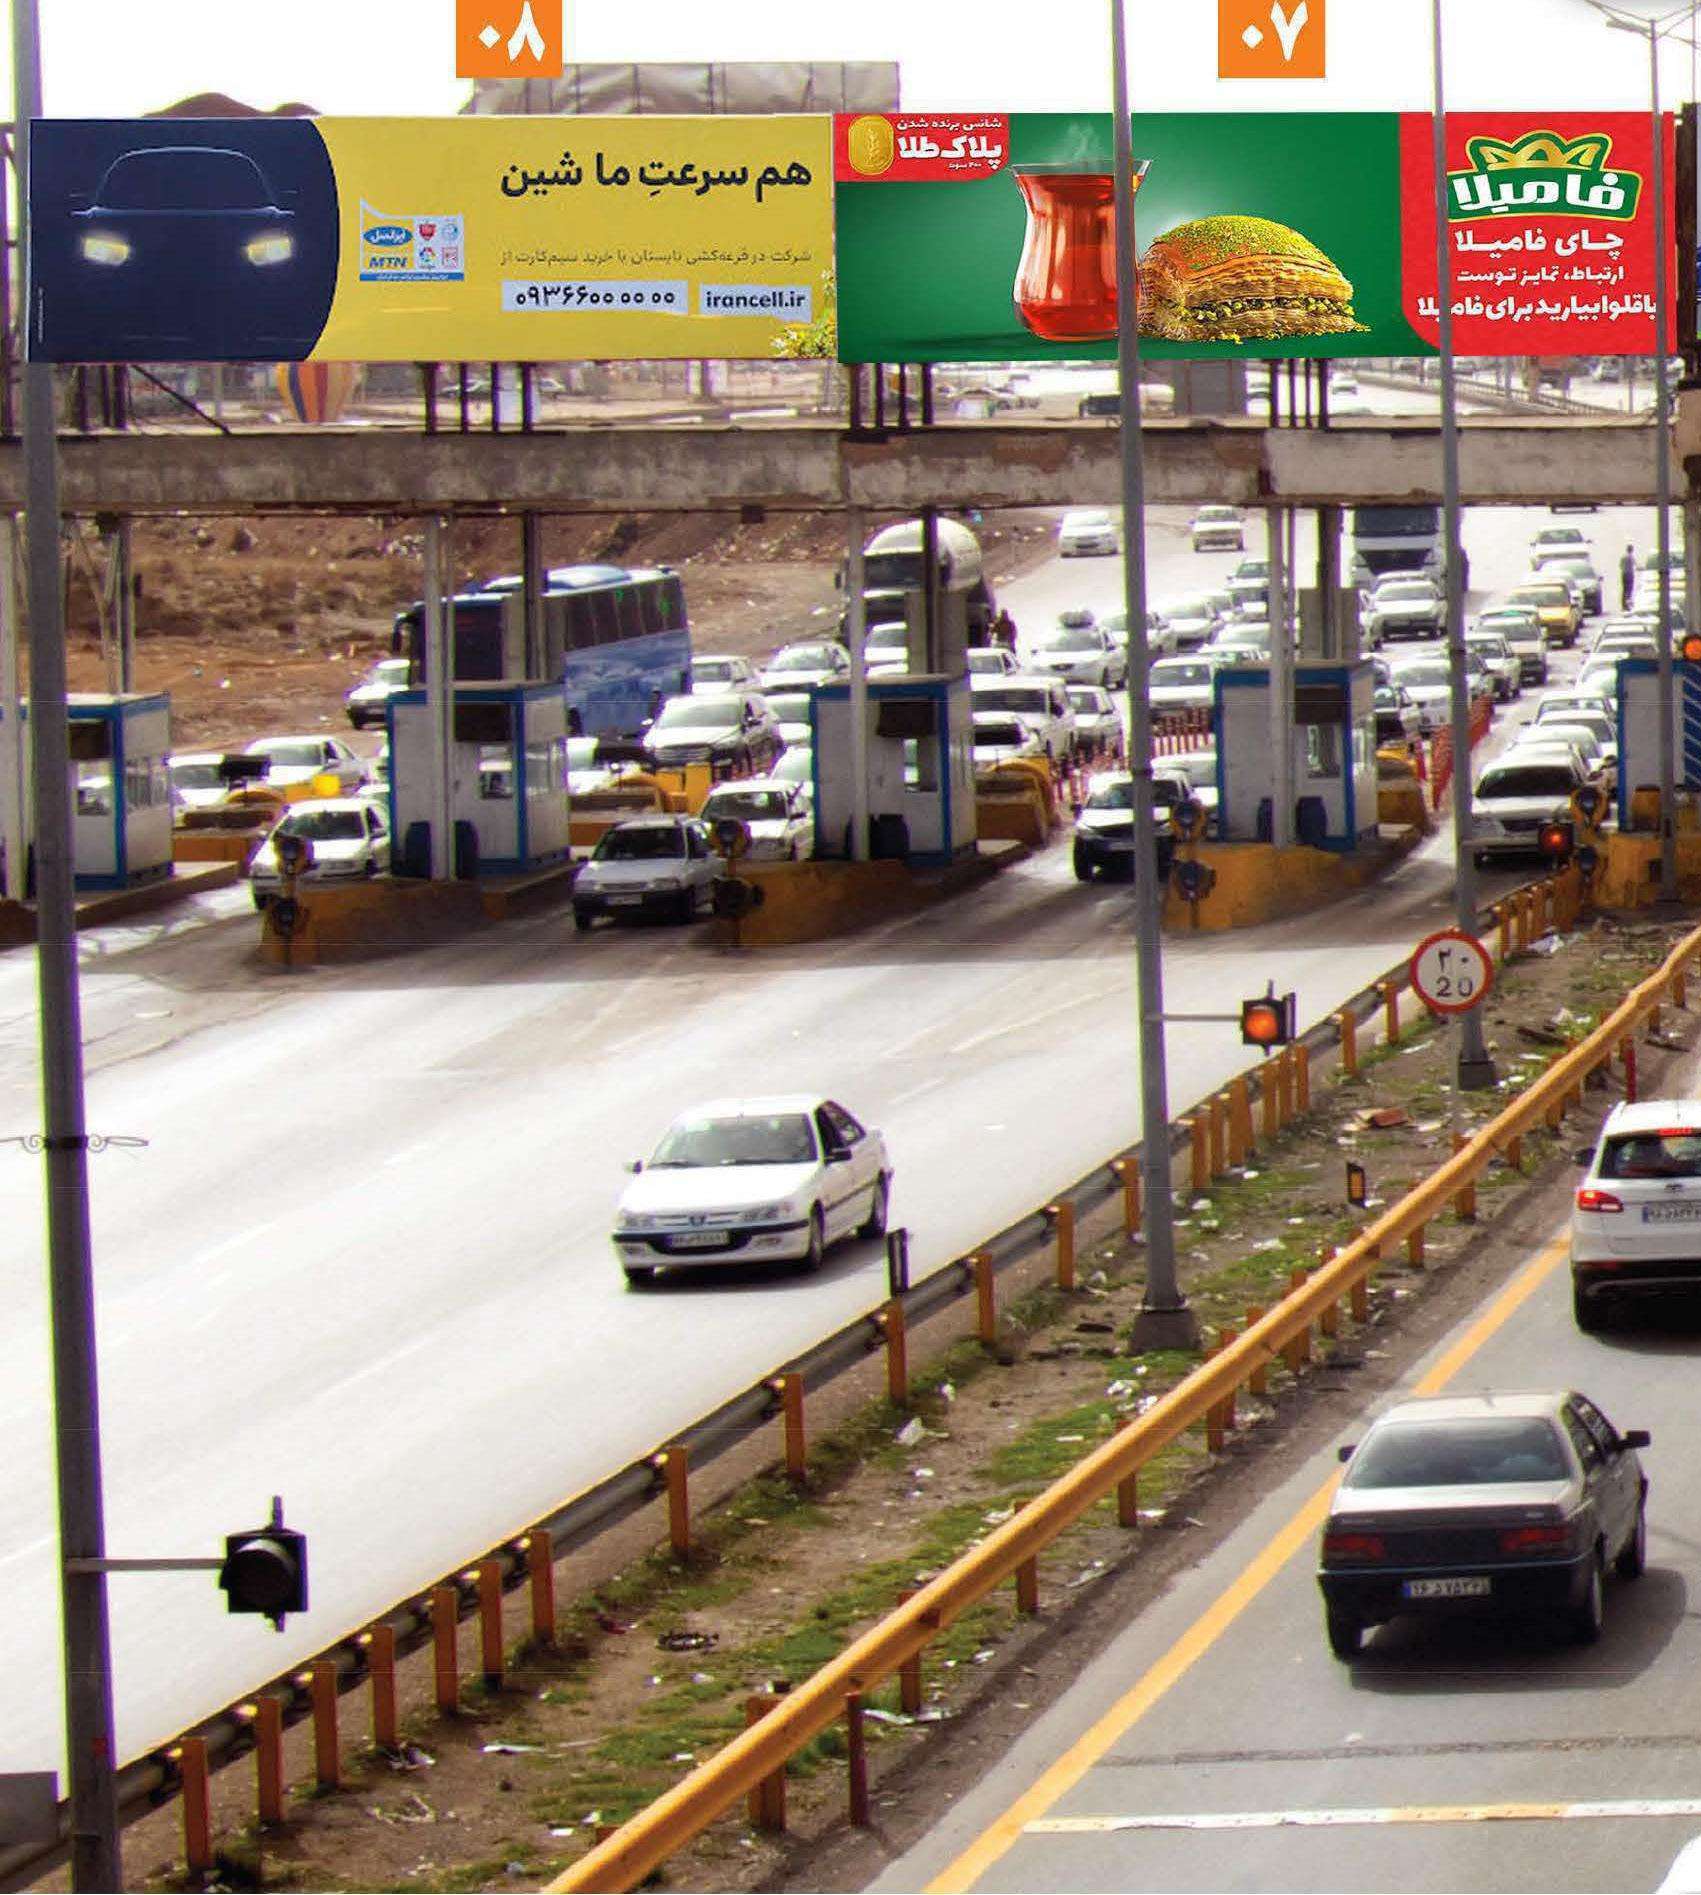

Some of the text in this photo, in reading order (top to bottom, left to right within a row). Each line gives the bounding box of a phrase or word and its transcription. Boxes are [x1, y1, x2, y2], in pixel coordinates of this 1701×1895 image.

[896, 117, 1002, 131] شانس برنده شدن
[897, 134, 1002, 170] پلاک طلا
[755, 160, 812, 203] هم
[1452, 172, 1625, 214] فامیلا
[1455, 227, 1625, 261] چای فامیلا
[369, 256, 408, 268] MTN
[1456, 266, 1518, 284] توست
[1520, 264, 1559, 286] تمایز
[706, 291, 806, 309] irancell.ir
[1438, 948, 1469, 972] ۲۰
[1436, 976, 1474, 998] 20
